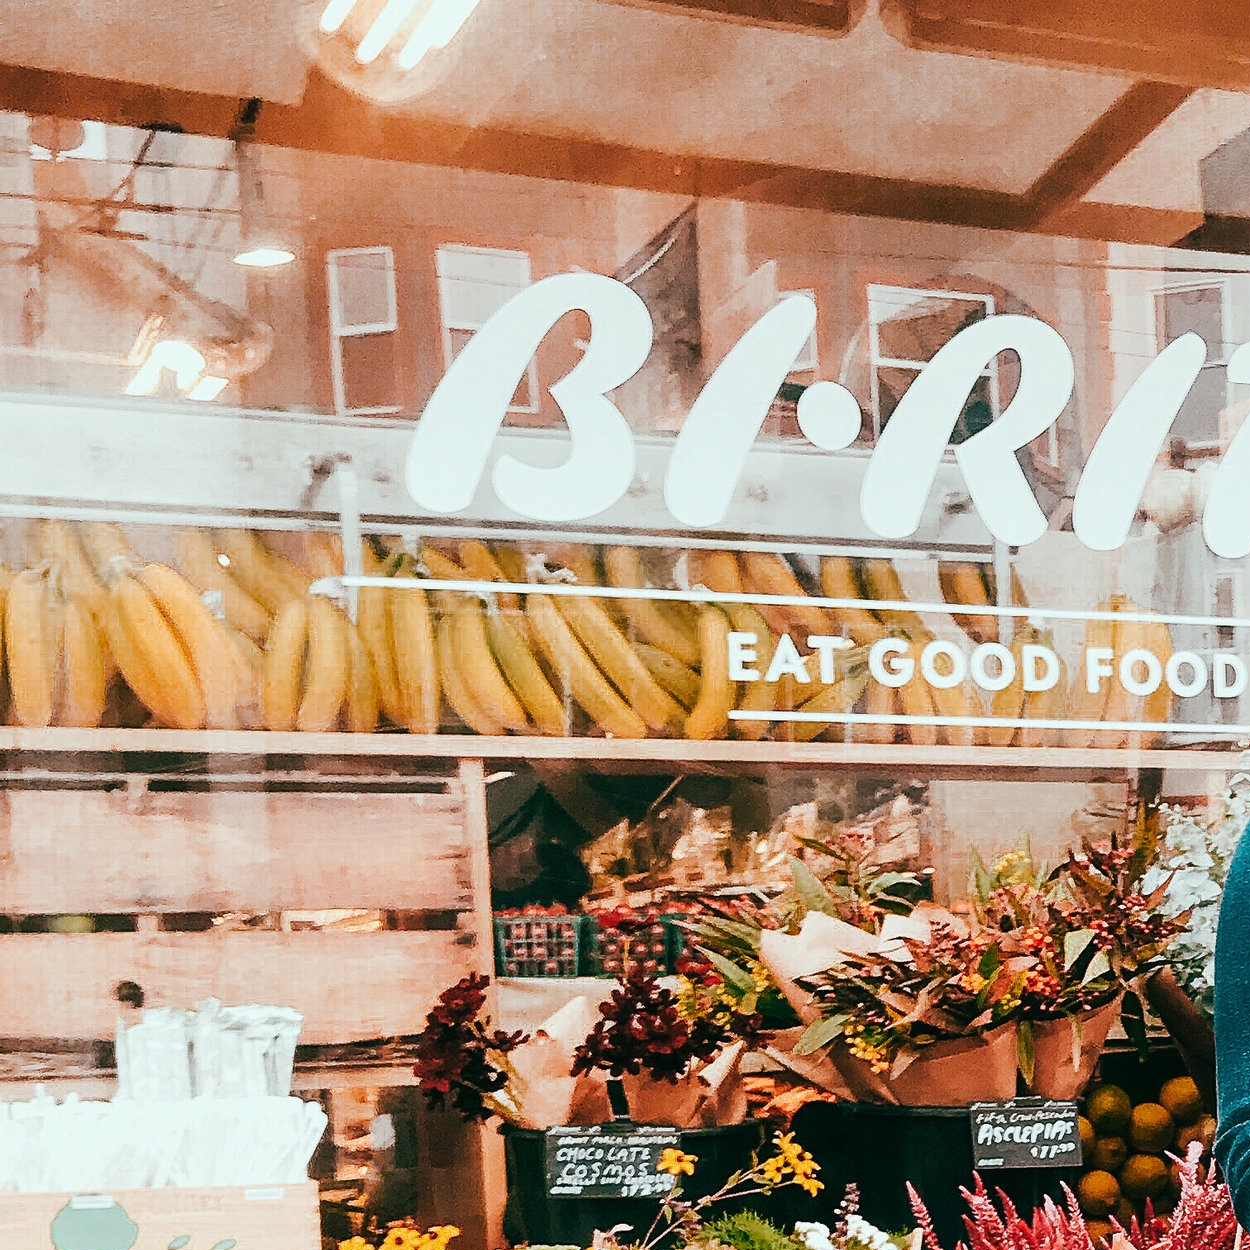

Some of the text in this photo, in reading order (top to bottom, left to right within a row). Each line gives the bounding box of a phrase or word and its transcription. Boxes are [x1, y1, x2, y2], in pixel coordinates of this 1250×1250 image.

[727, 632, 1248, 699] EAT GOOD FOOD
[561, 1162, 650, 1178] COSMOS
